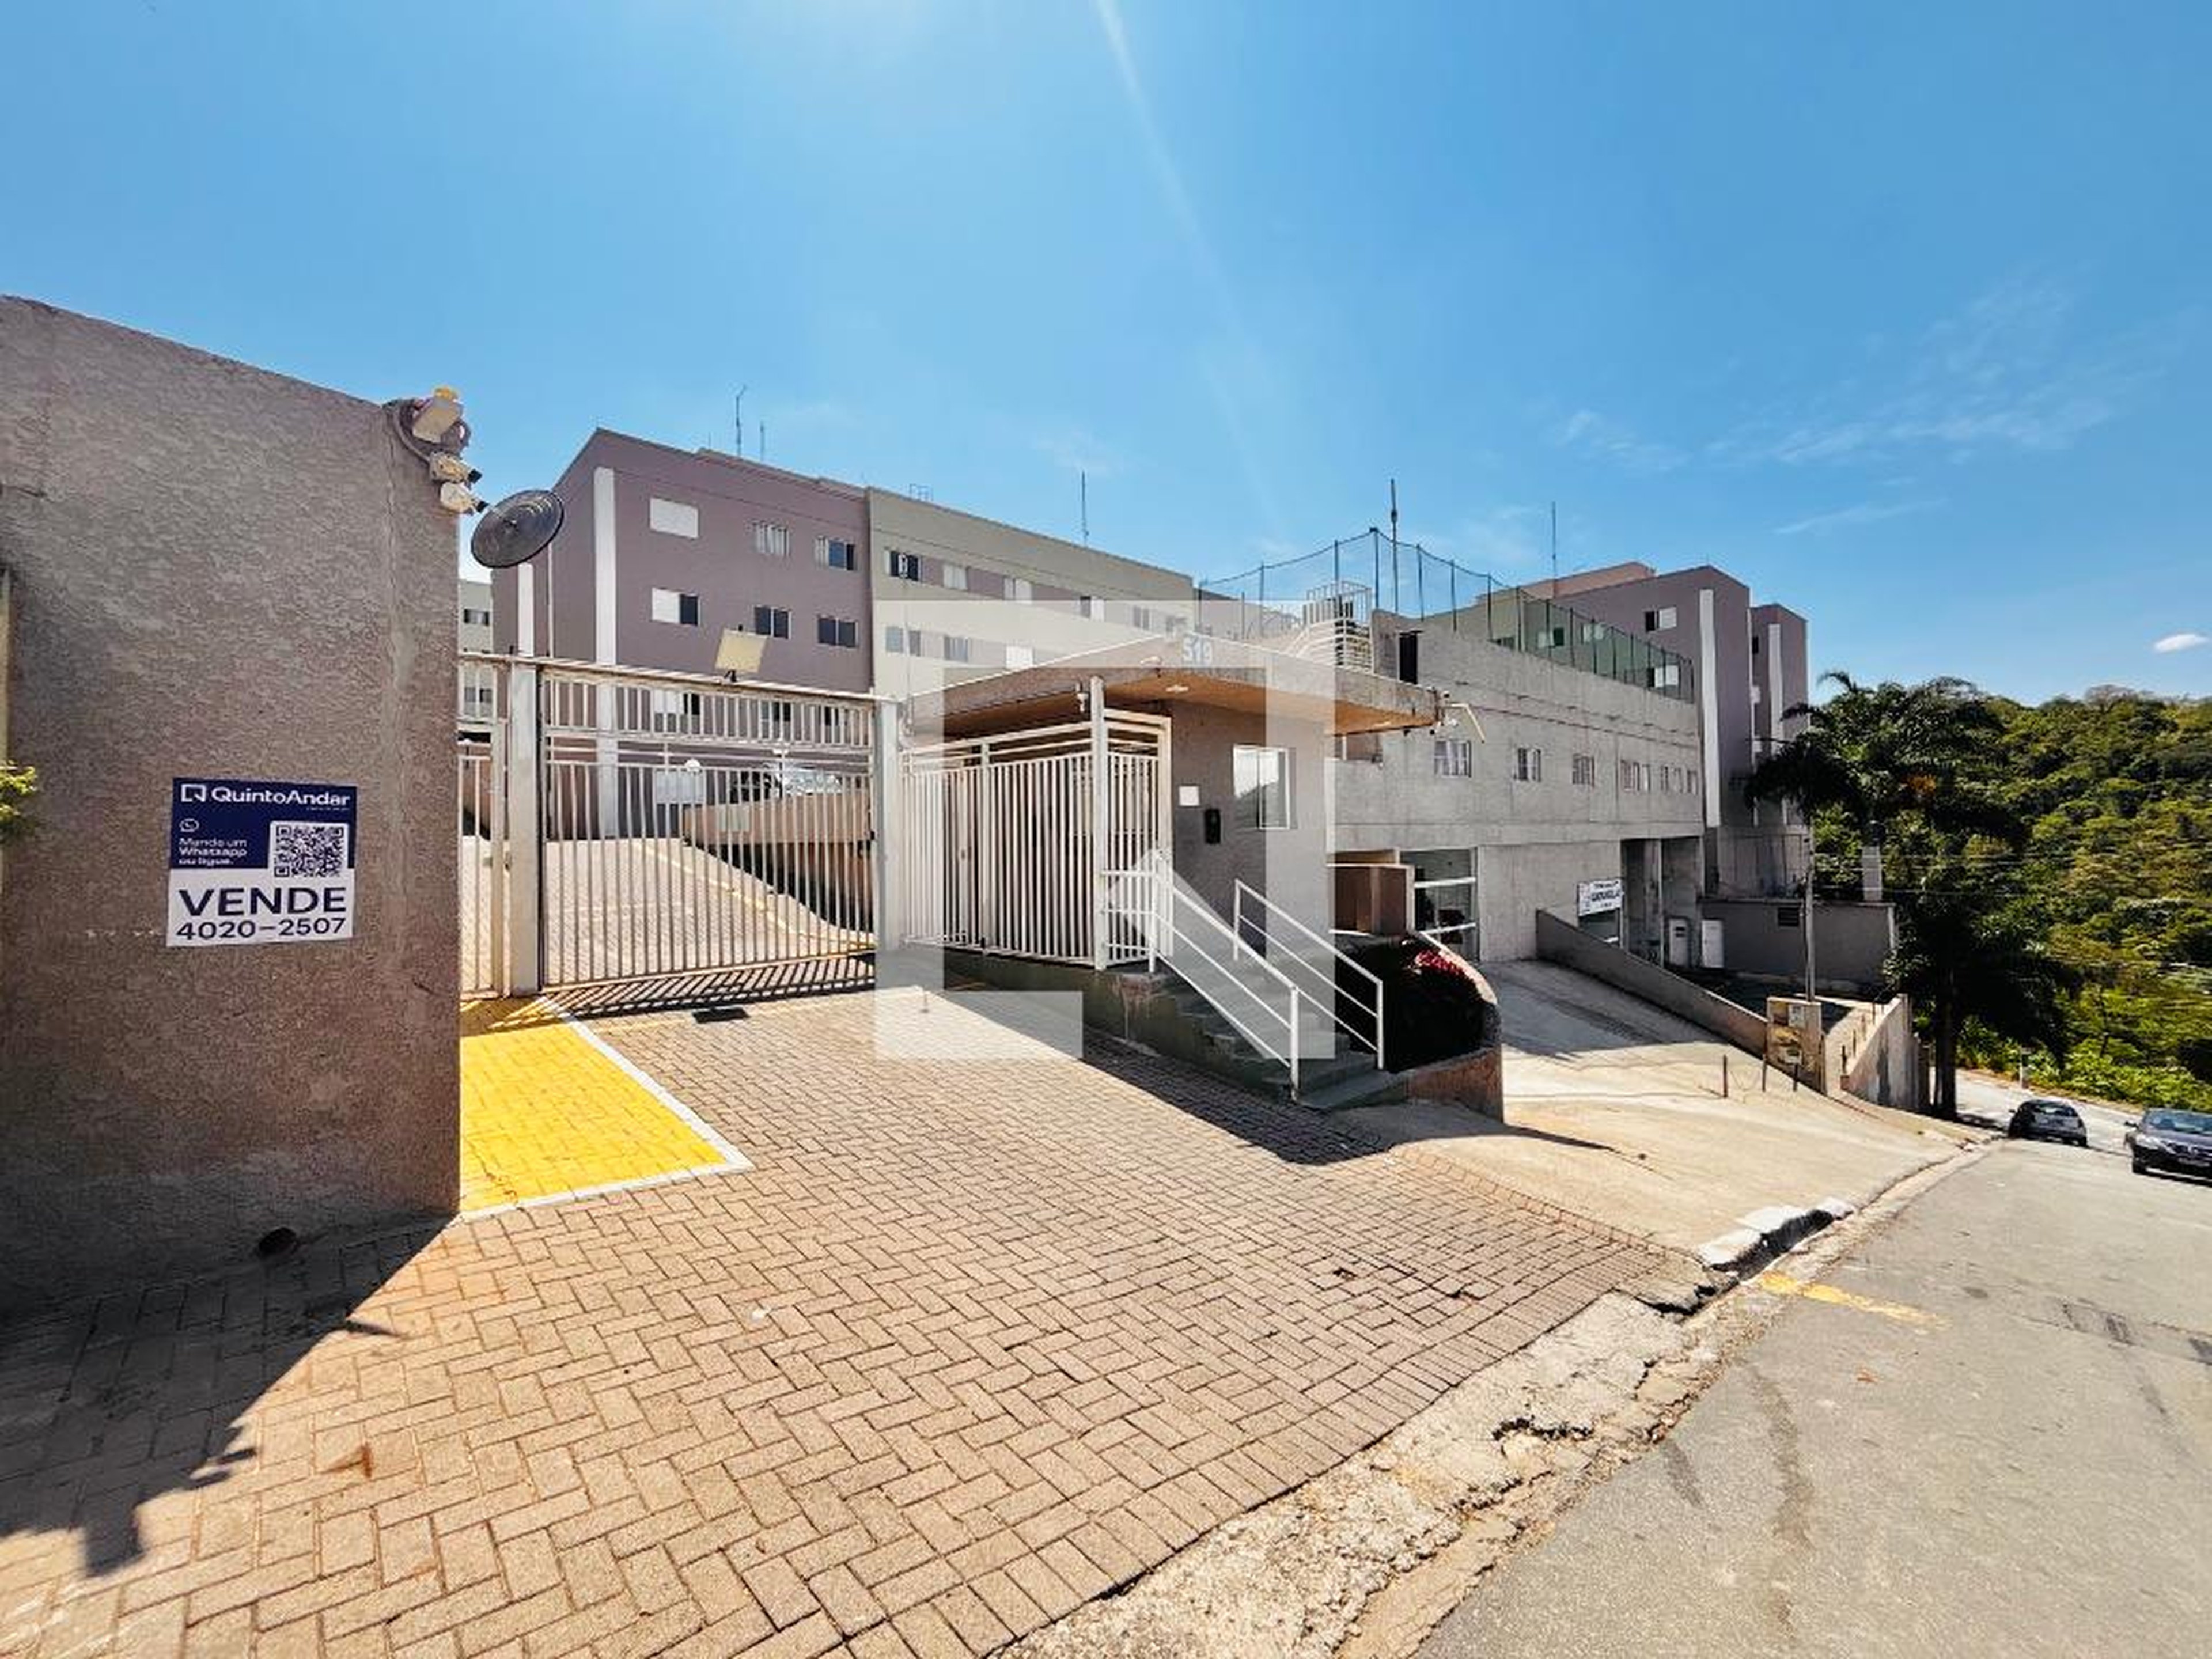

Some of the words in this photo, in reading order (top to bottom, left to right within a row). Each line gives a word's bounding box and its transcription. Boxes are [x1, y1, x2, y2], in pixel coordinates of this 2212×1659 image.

[211, 787, 350, 806] QuintoAndar
[179, 887, 346, 916] VENDE
[176, 918, 346, 940] 4020-2507
